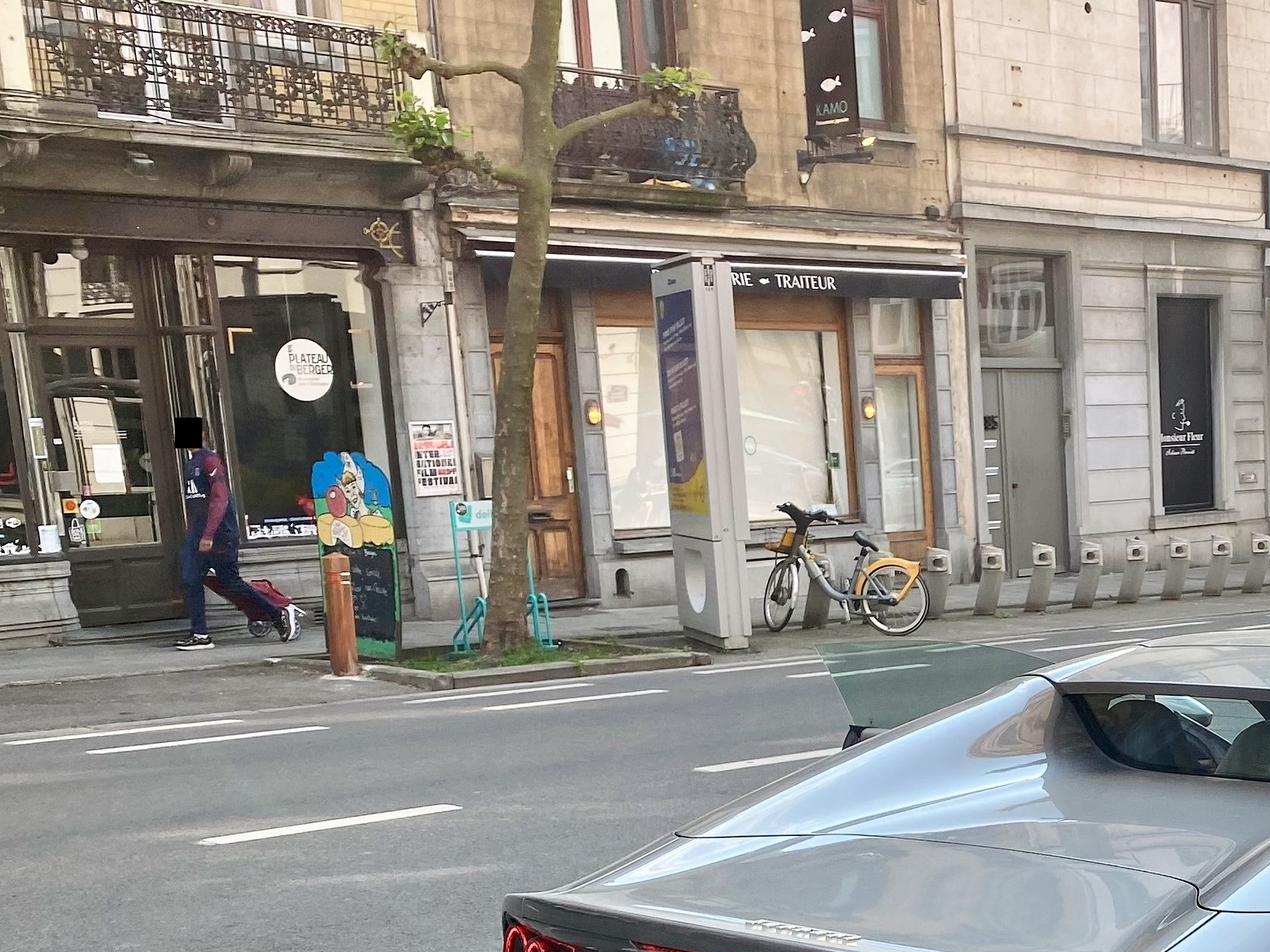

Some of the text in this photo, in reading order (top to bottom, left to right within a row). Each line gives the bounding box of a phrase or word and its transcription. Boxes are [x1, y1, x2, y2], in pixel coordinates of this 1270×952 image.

[816, 100, 848, 116] KAMO
[774, 273, 837, 291] TRAITEUR
[289, 353, 329, 363] PLATEAU
[297, 364, 334, 374] BERGER
